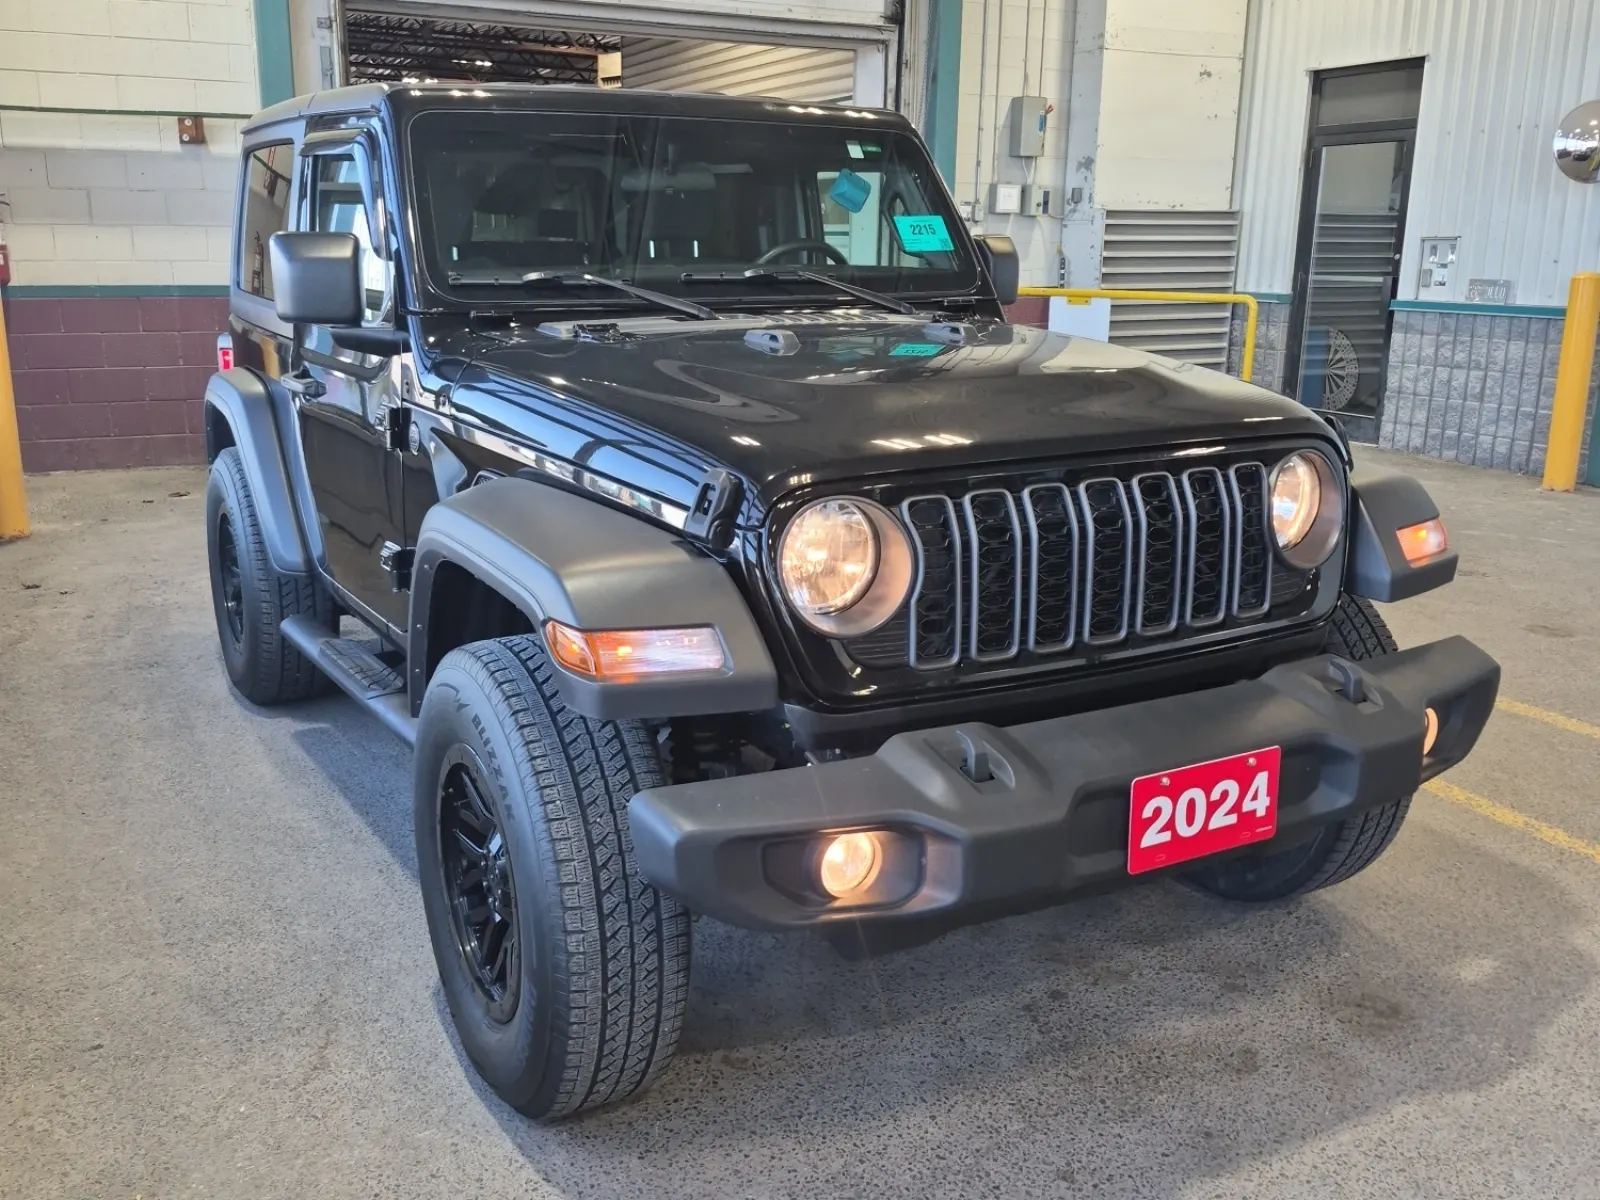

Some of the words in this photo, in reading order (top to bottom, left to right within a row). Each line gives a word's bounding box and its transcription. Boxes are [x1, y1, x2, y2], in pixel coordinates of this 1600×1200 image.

[909, 223, 937, 236] 2215
[471, 713, 516, 821] BLIZZAK
[1140, 770, 1271, 849] 2024
